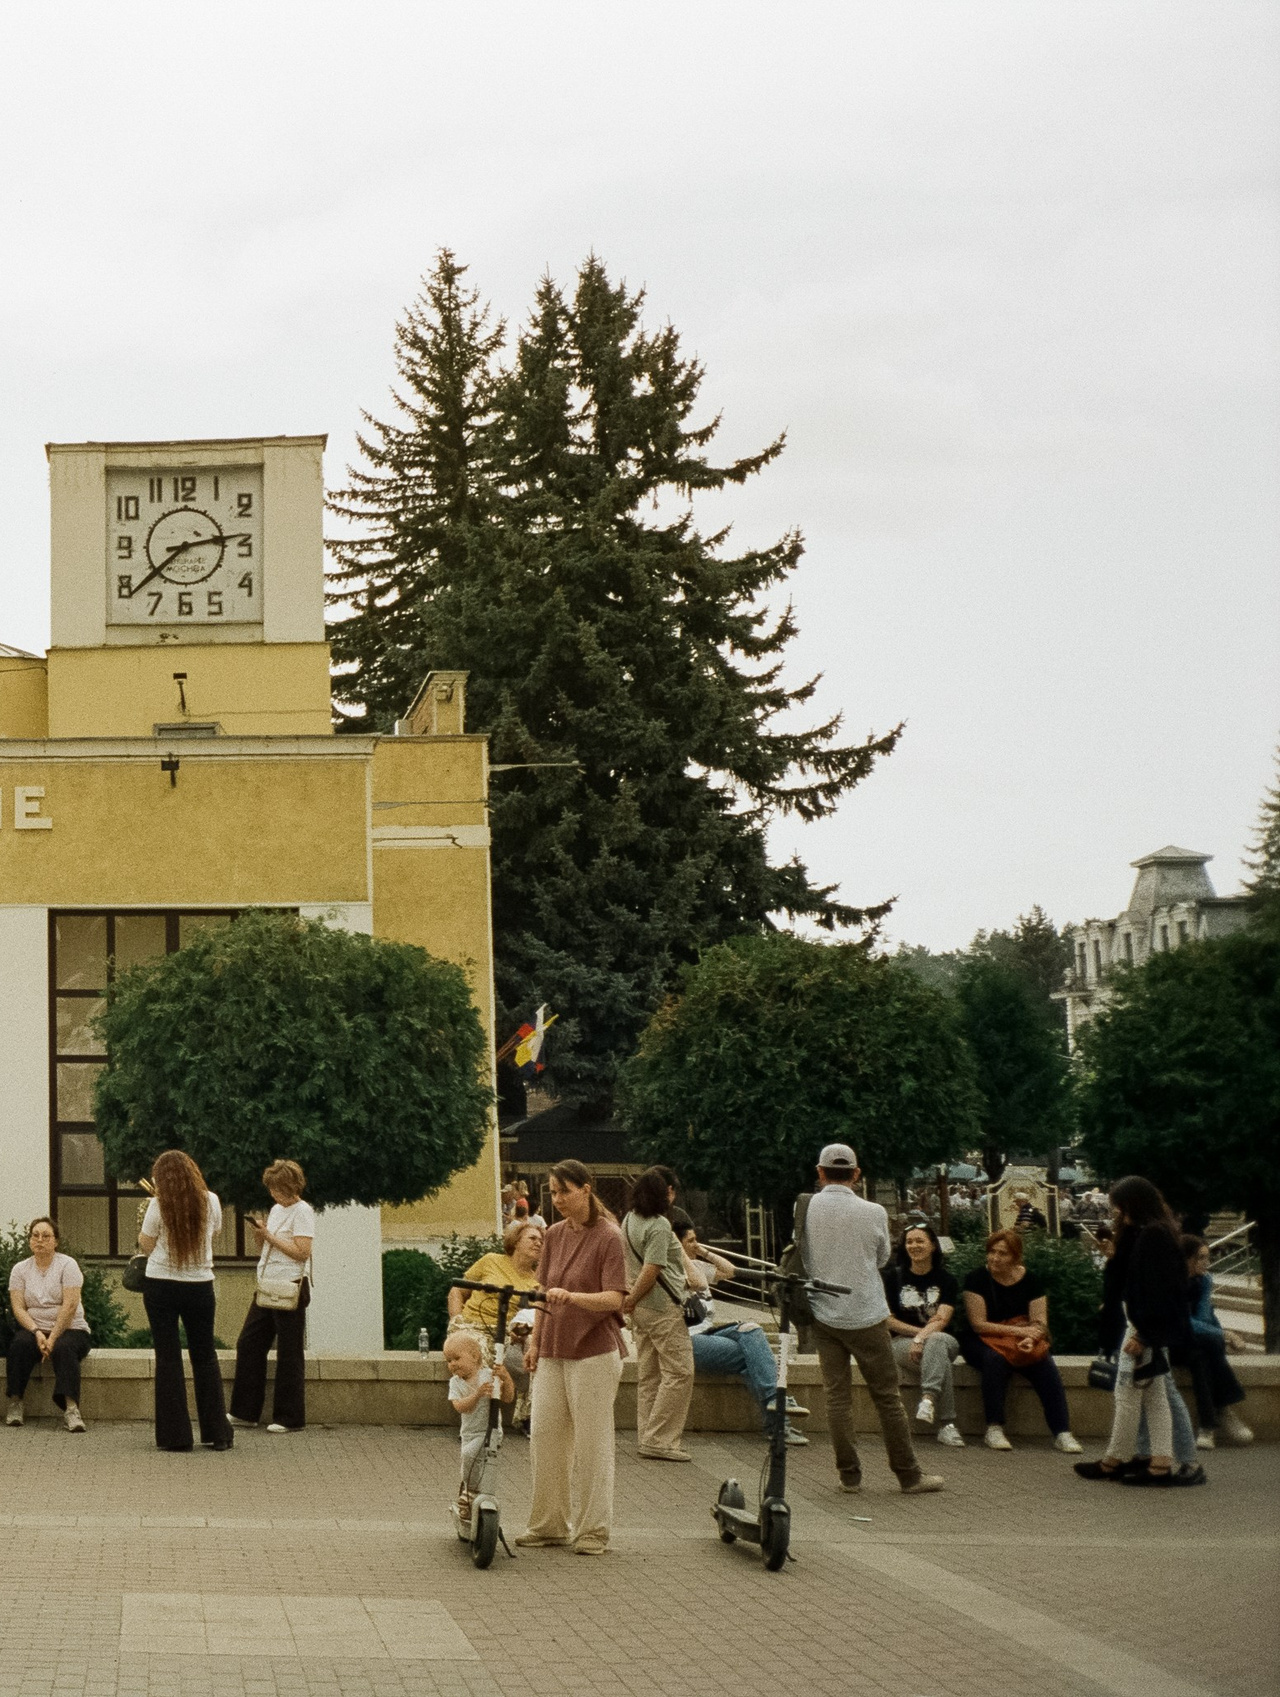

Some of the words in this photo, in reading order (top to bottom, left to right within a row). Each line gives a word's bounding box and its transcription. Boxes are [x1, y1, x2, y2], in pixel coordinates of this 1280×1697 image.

[149, 477, 162, 502] 11
[173, 476, 196, 502] 12
[213, 476, 219, 501] 1
[117, 496, 139, 520] 10
[237, 493, 253, 518] 2
[118, 536, 132, 559] 9
[237, 534, 252, 557] 3
[118, 575, 132, 599] 8
[238, 572, 253, 597] 4
[147, 592, 162, 616] 7
[178, 592, 193, 616] 6
[207, 591, 223, 616] 5
